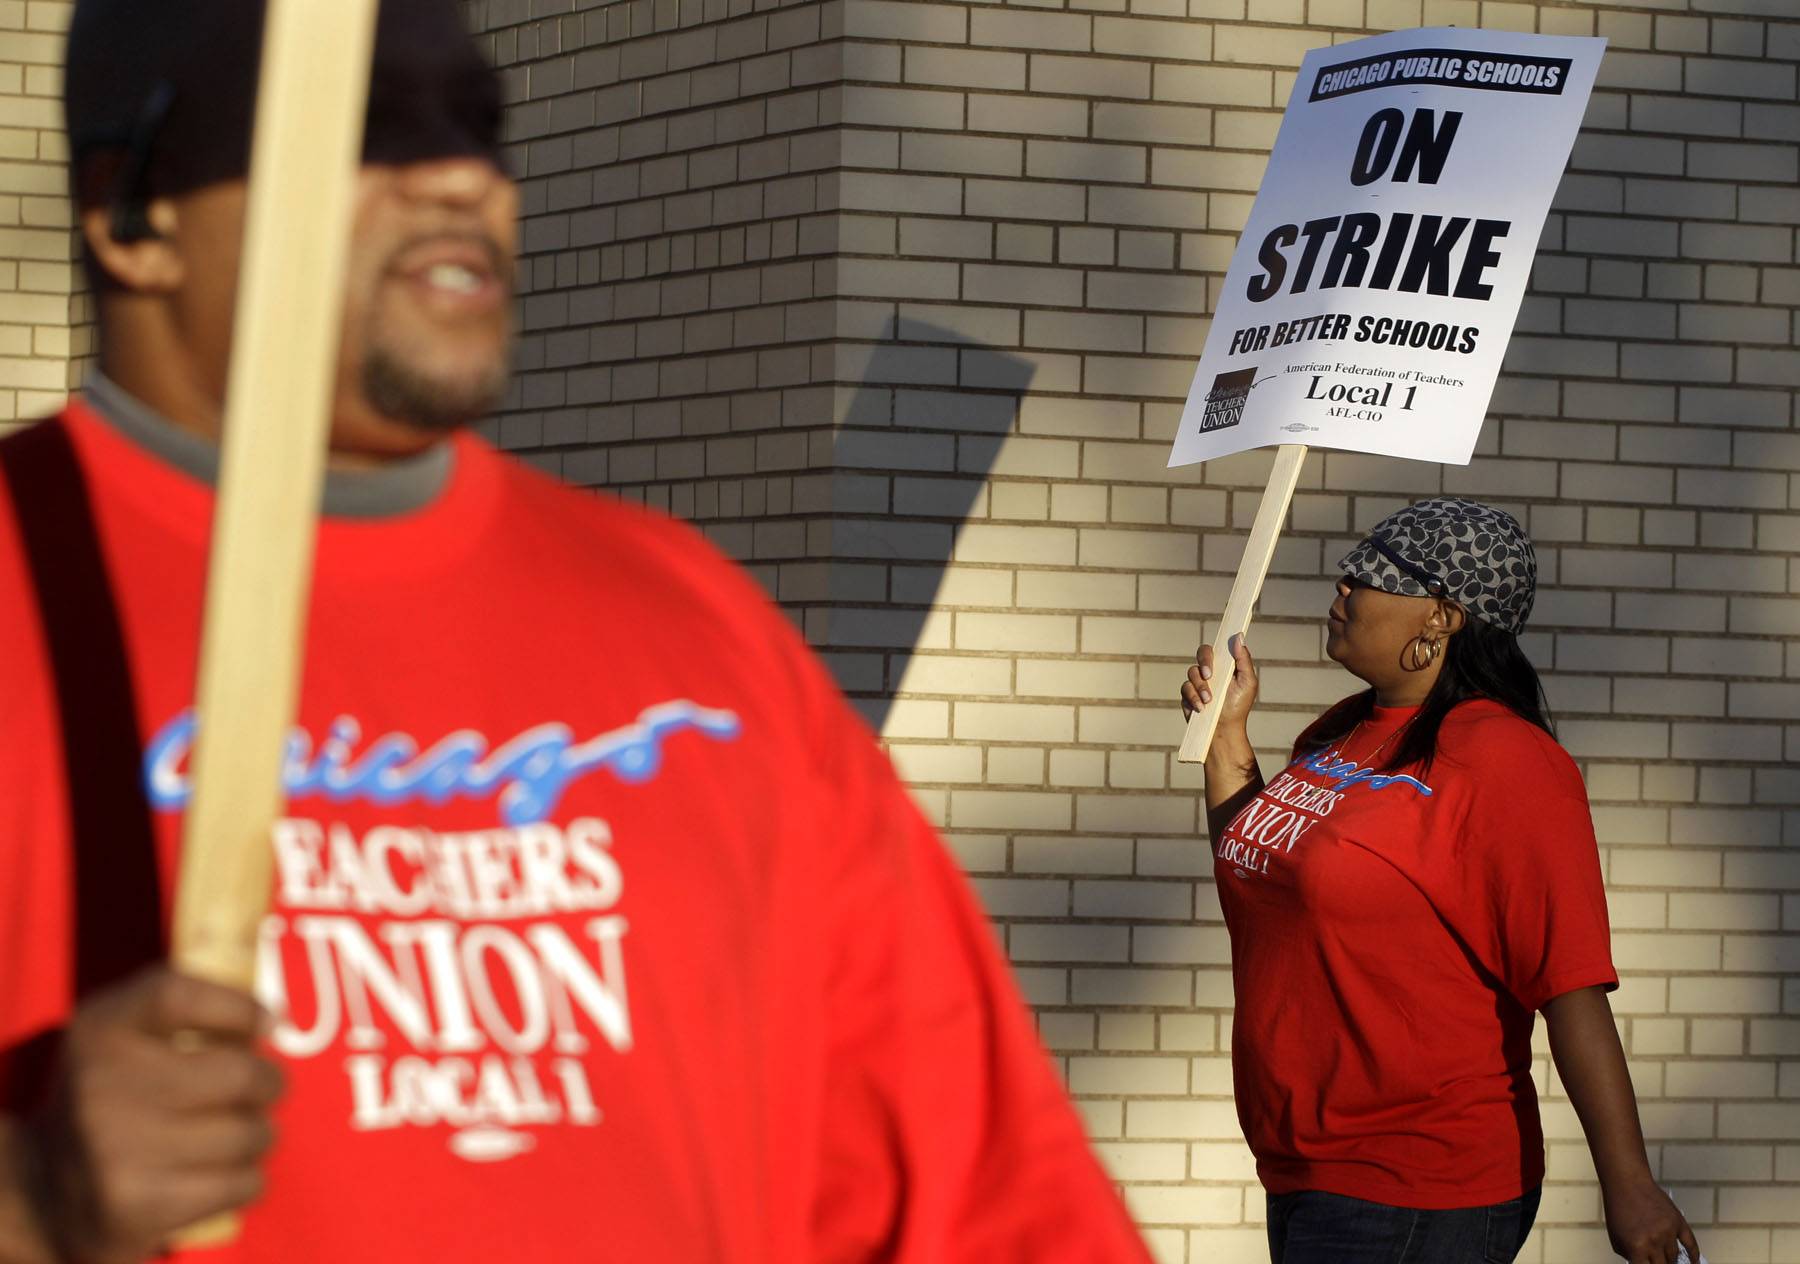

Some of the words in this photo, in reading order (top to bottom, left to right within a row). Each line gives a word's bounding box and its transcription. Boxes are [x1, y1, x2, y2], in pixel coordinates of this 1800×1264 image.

[1318, 61, 1391, 94] CHICAGO
[1390, 56, 1460, 81] PUBLIC
[1464, 59, 1561, 88] SCHOOLS
[1350, 107, 1463, 186] ON
[1247, 212, 1511, 303] STRIKE
[1228, 326, 1270, 356] FOR
[1270, 314, 1351, 348] BETTER
[1355, 315, 1479, 354] SCHOOLS
[1284, 362, 1331, 374] American
[1334, 363, 1395, 378] Federation
[1398, 370, 1412, 380] of
[1413, 371, 1464, 388] Teachers
[1304, 376, 1390, 407] Local
[1401, 385, 1418, 411] 1
[1202, 406, 1243, 429] UNION
[1206, 394, 1246, 414] TEACHERS
[1326, 407, 1382, 422] AFL-CIO
[1217, 836, 1259, 871] LOCAL
[1260, 852, 1269, 875] 1
[254, 914, 633, 1056] UNION
[343, 1055, 558, 1129] LOCAL
[557, 1056, 600, 1125] 1
